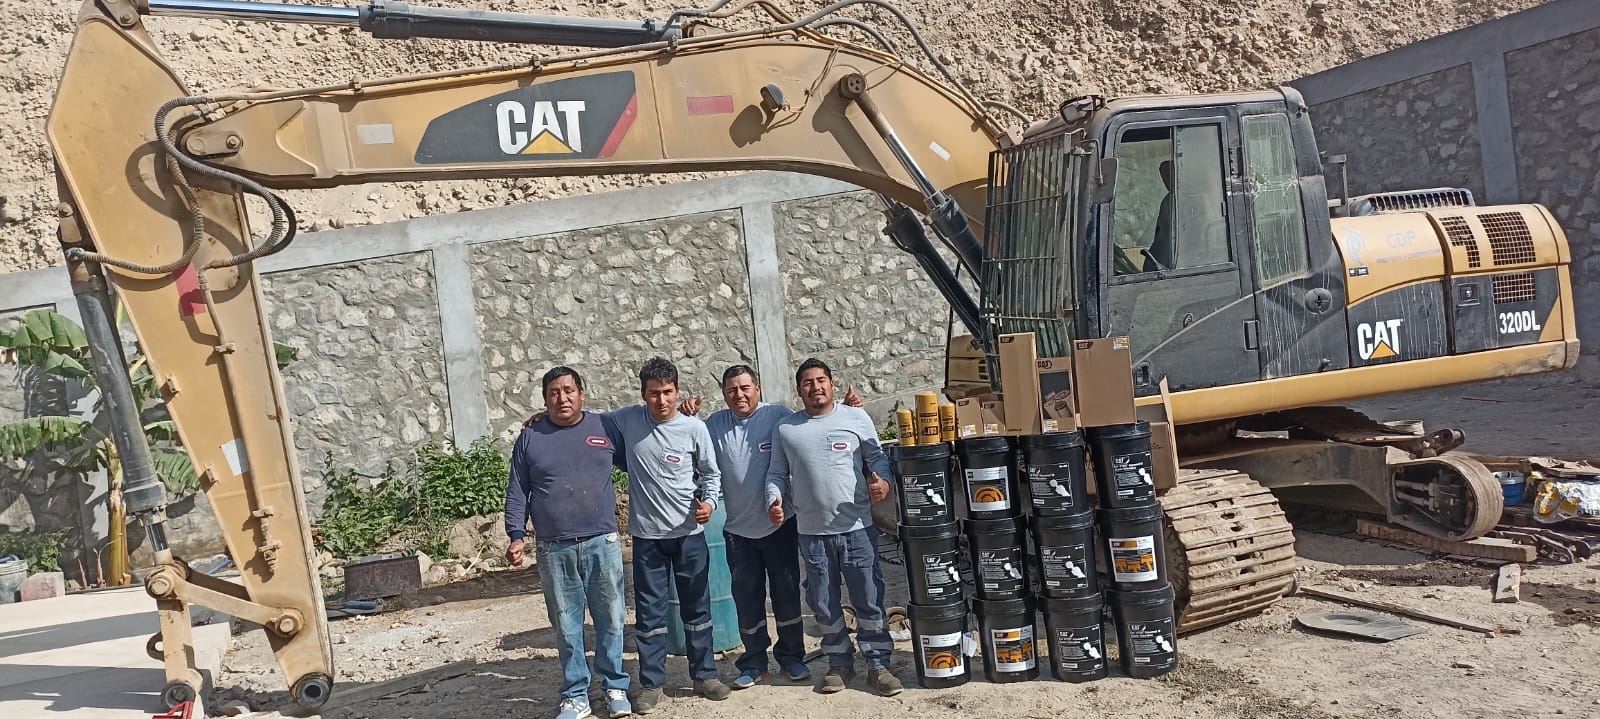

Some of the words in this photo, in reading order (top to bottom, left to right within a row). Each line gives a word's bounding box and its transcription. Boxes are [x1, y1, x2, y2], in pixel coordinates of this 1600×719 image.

[496, 100, 585, 155] CAT
[1386, 231, 1416, 249] CDP
[1499, 310, 1540, 334] 320DL
[1357, 318, 1402, 360] CAT
